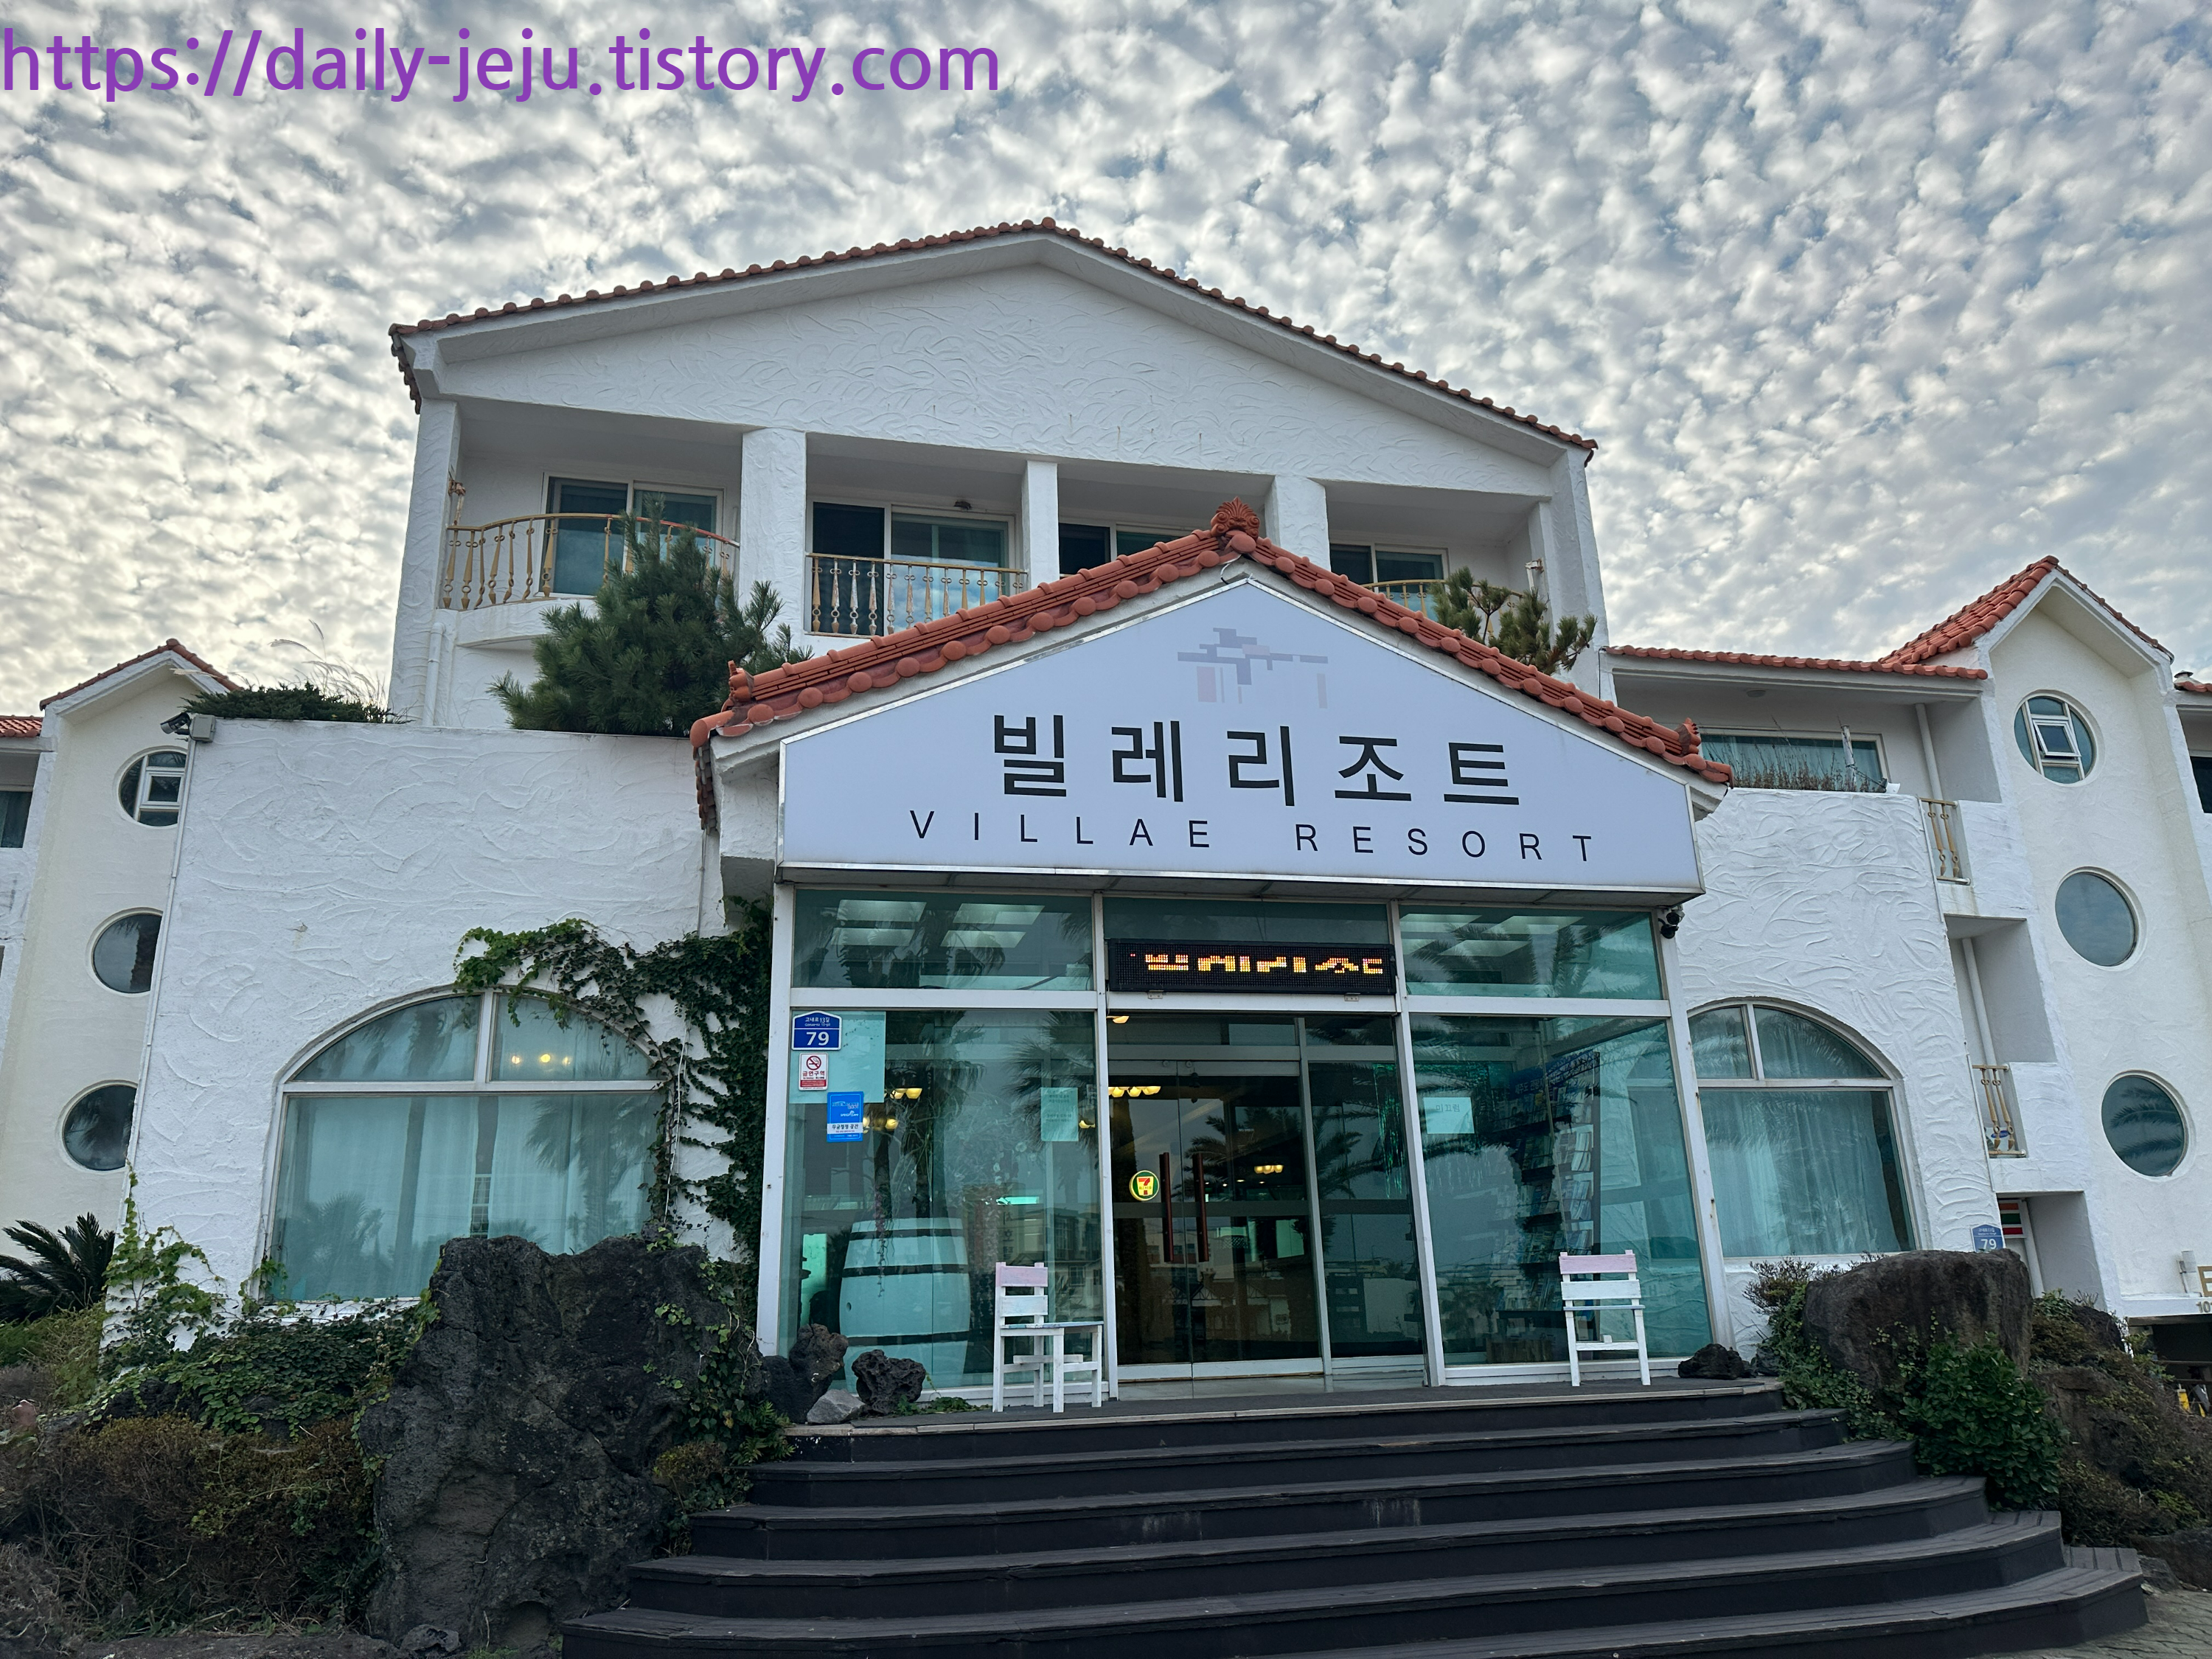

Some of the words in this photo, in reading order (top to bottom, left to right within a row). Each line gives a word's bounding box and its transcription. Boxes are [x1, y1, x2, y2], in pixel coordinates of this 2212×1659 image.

[993, 714, 1520, 807] 빌레리조트
[909, 809, 1209, 848] VILLAE
[1295, 824, 1592, 862] RESORT
[806, 1032, 830, 1046] 79
[1436, 1104, 1461, 1113] 미끄럼
[1980, 1239, 1997, 1250] 79
